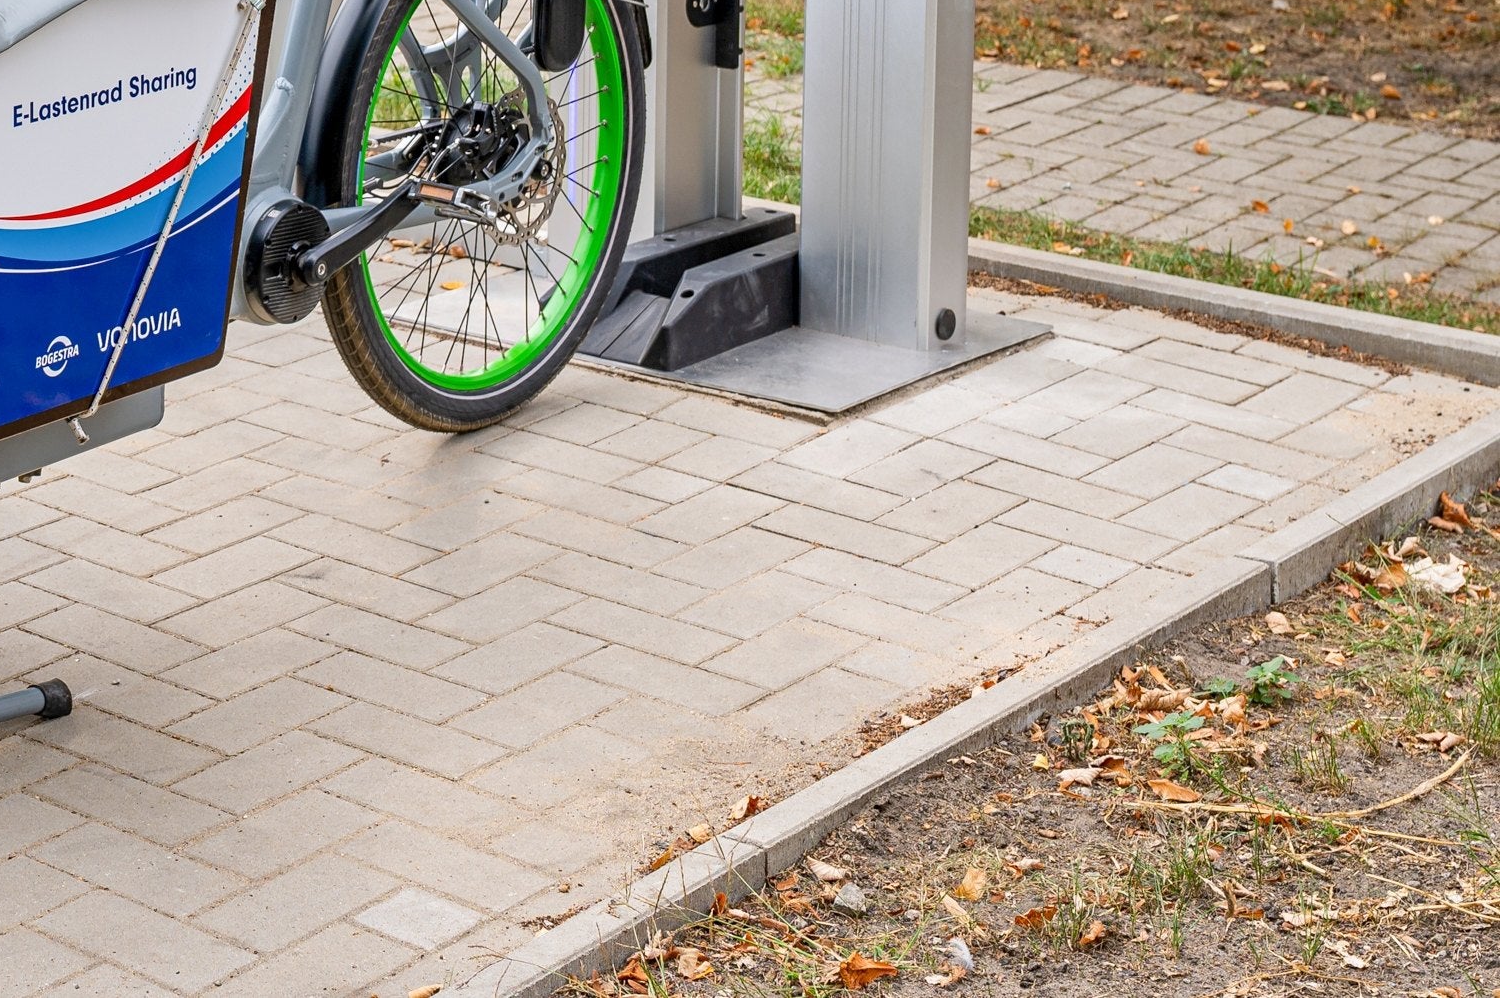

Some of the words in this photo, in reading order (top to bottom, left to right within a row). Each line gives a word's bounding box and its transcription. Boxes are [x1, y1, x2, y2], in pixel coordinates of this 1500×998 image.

[13, 80, 122, 128] E-Lastenrad
[129, 67, 197, 98] Sharing
[35, 344, 79, 369] BOGESTRA
